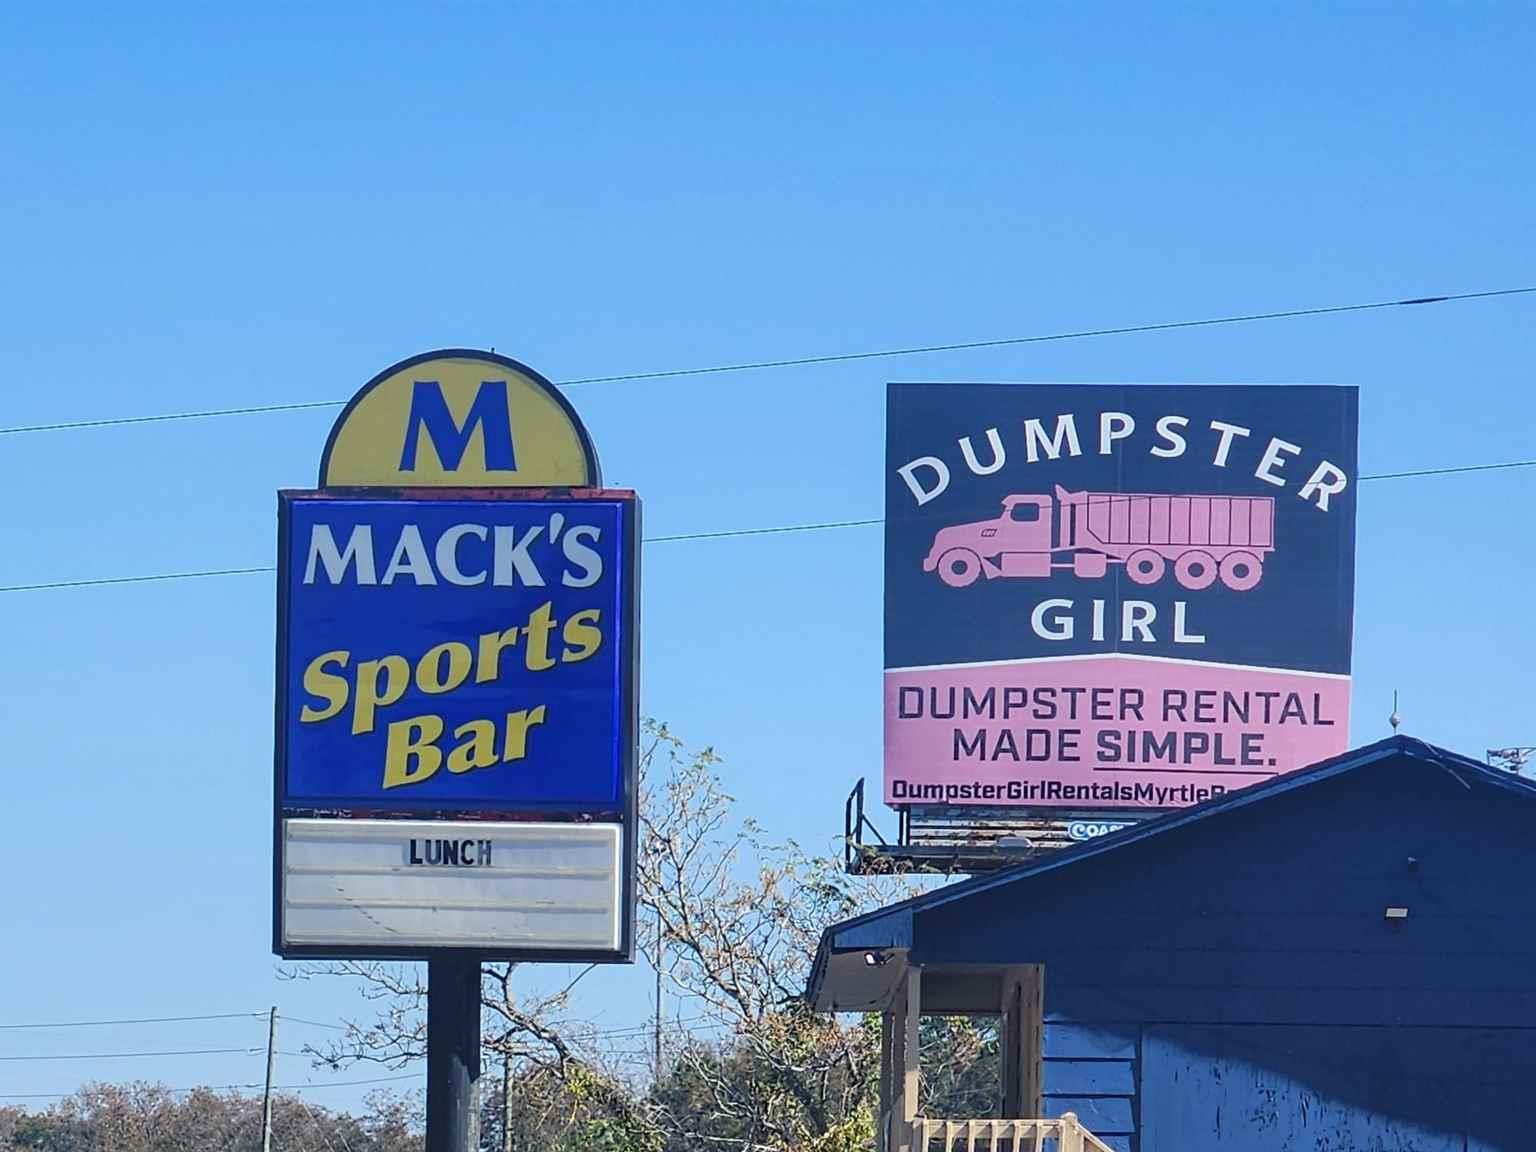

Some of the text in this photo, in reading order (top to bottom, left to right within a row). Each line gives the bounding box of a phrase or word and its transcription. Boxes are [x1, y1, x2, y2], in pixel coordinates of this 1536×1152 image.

[398, 380, 517, 472] M
[896, 411, 1348, 513] DUMPSTER
[302, 512, 604, 588] MACK'S
[1030, 599, 1206, 643] GIRL
[298, 599, 602, 735] Sports
[898, 685, 1335, 726] DUMPSTER RENTAL
[382, 704, 546, 790] Bar
[952, 728, 1277, 767] MADE SIMPLE.
[409, 839, 493, 866] LUNCH
